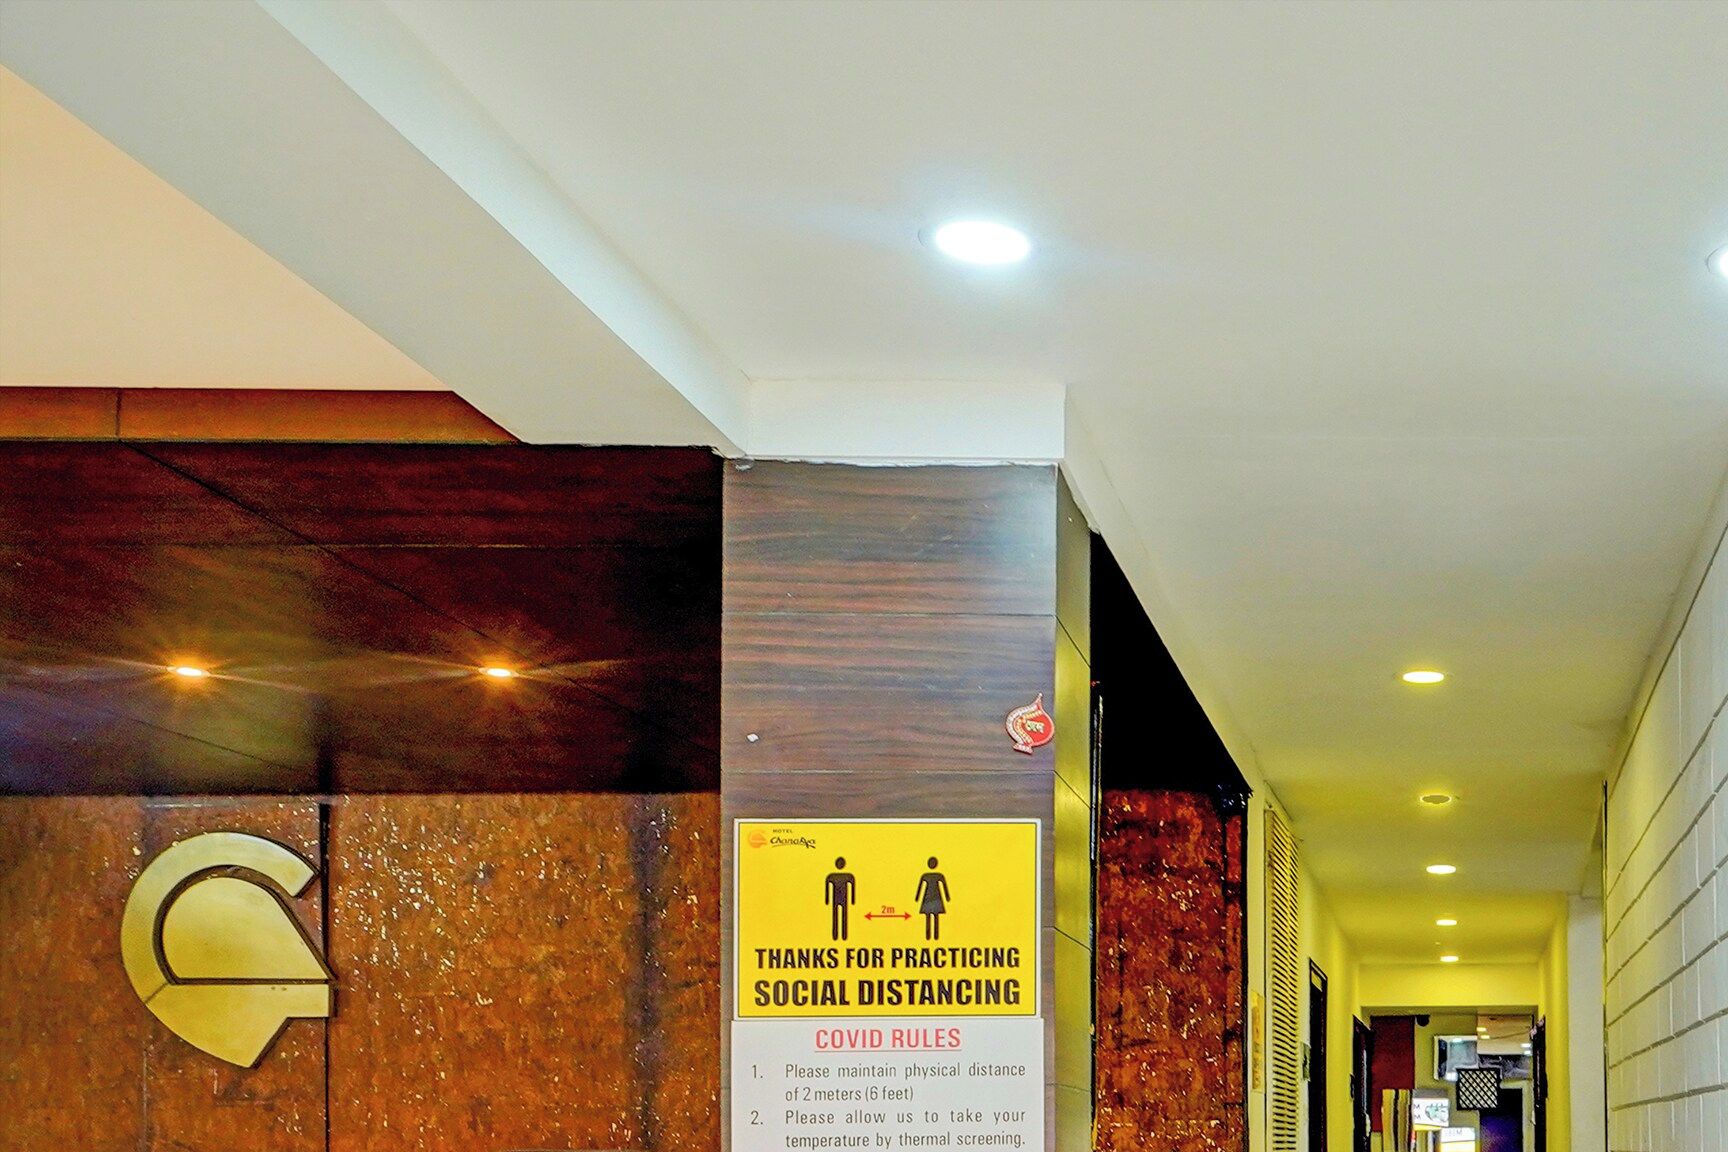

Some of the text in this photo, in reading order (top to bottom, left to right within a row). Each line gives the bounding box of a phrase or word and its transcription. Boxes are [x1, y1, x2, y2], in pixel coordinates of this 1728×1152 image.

[881, 905, 895, 914] 2m
[754, 947, 1020, 969] THANKS FOR PRACTICING
[754, 979, 1021, 1007] SOCIAL DISTANCING
[815, 1028, 961, 1049] COVID RULES
[752, 1062, 1025, 1080] 1. Please maintain physical distance
[785, 1085, 913, 1102] of 2 meters (6 feet)
[750, 1108, 1025, 1126] 2. Please allow us to take your
[786, 1130, 1025, 1151] temperature by thermal screening.
